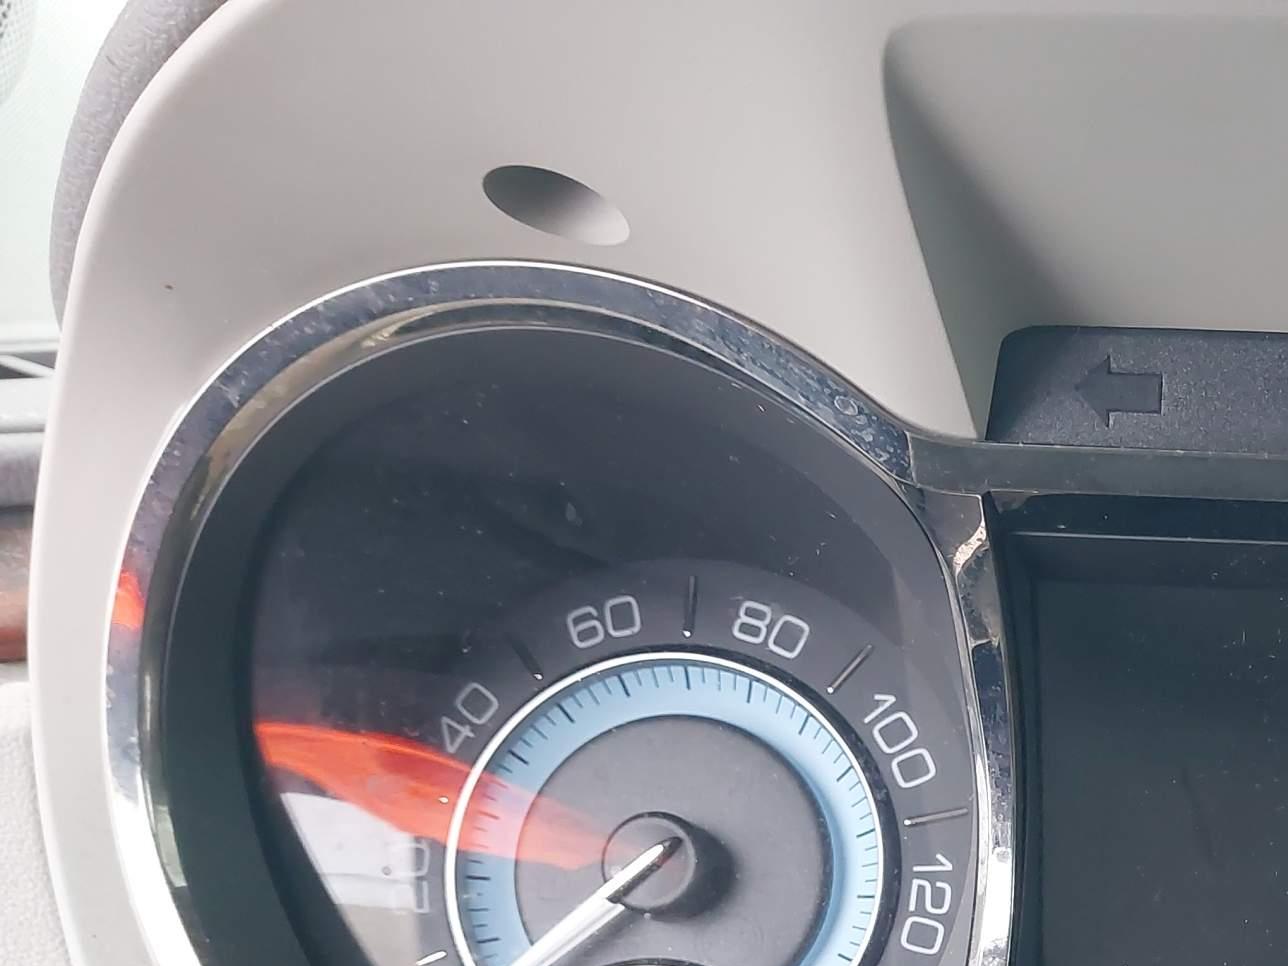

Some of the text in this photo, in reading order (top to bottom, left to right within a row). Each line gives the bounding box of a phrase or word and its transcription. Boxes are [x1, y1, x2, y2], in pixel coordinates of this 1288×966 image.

[567, 594, 641, 648] 60
[732, 600, 811, 659] 80
[441, 682, 499, 754] 40
[859, 692, 936, 788] 100
[901, 854, 954, 955] 120
